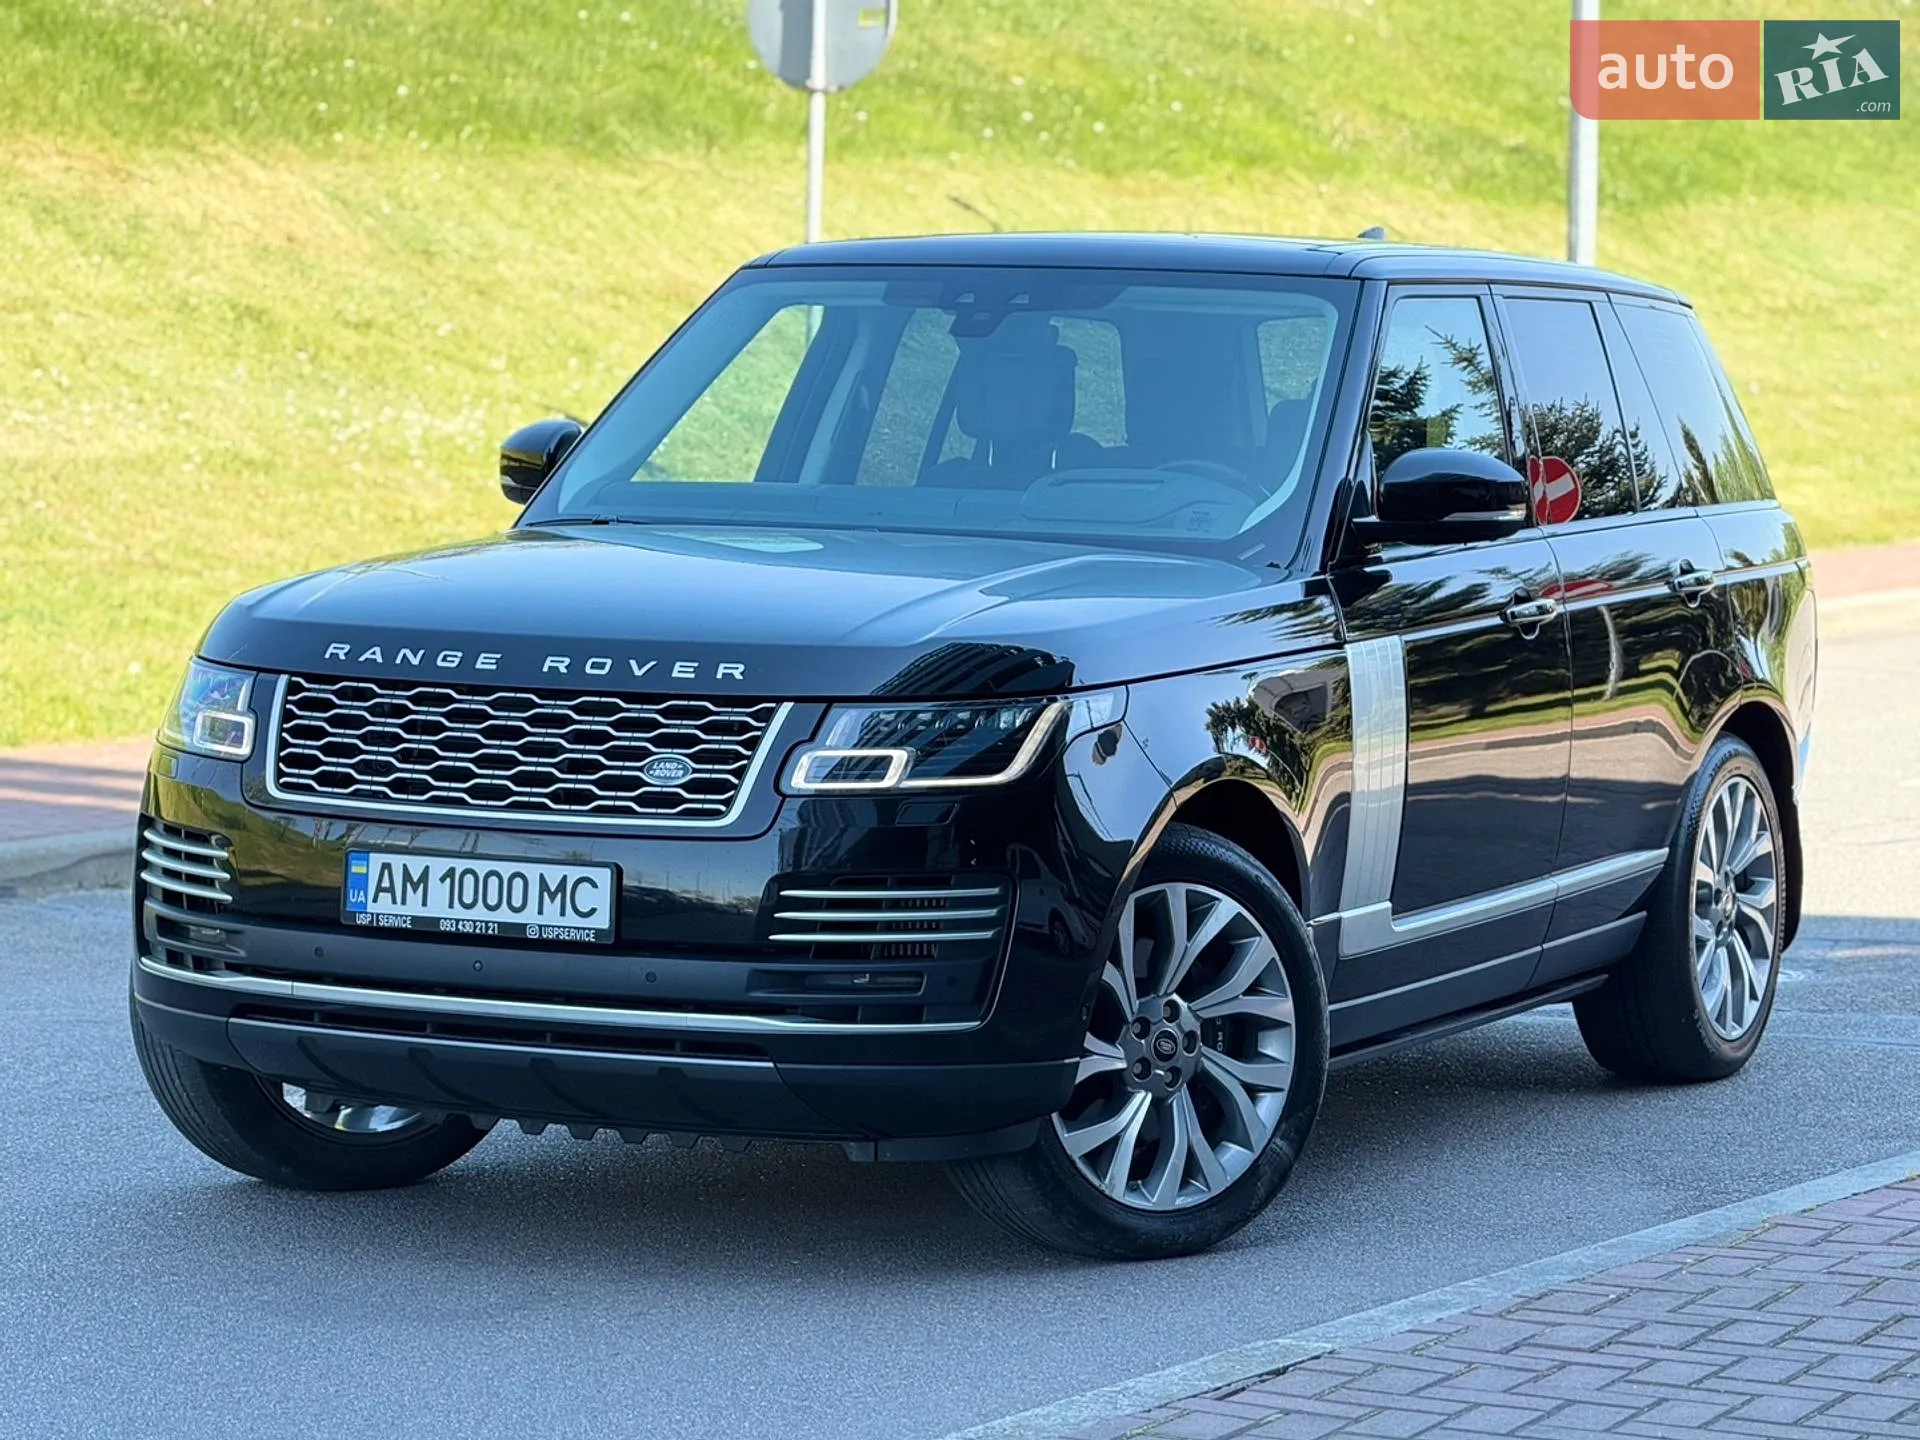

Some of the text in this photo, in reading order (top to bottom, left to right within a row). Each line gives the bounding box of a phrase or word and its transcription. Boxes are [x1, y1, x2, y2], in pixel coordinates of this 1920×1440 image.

[323, 642, 747, 680] RANGE ROVER
[349, 888, 367, 904] UA
[371, 862, 600, 919] AM 1000 MC
[355, 911, 372, 926] USP
[378, 914, 412, 929] SERVICE
[439, 918, 499, 935] 093 430 21 21
[541, 926, 596, 942] USPSERVICE
